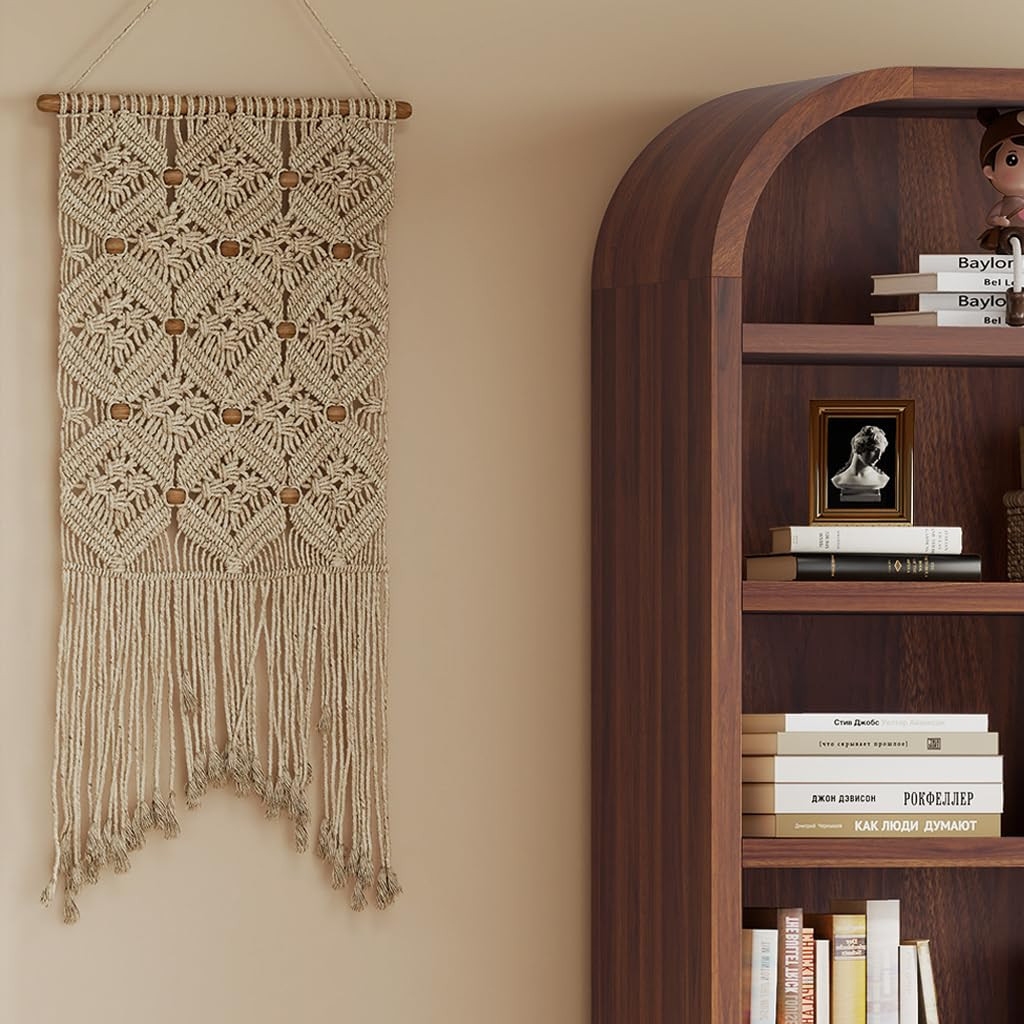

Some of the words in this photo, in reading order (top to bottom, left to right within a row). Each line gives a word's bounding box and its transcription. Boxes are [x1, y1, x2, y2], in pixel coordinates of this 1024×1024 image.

[984, 278, 1001, 286] Bel
[958, 295, 1007, 310] Baylo
[984, 316, 1001, 324] Bel
[853, 718, 880, 727] Джобс
[903, 791, 975, 807] РОКФЕЛЛЕР
[854, 820, 879, 832] КАК
[881, 820, 919, 833] ЛЮДИ
[923, 819, 977, 833] ДУМАЮТ
